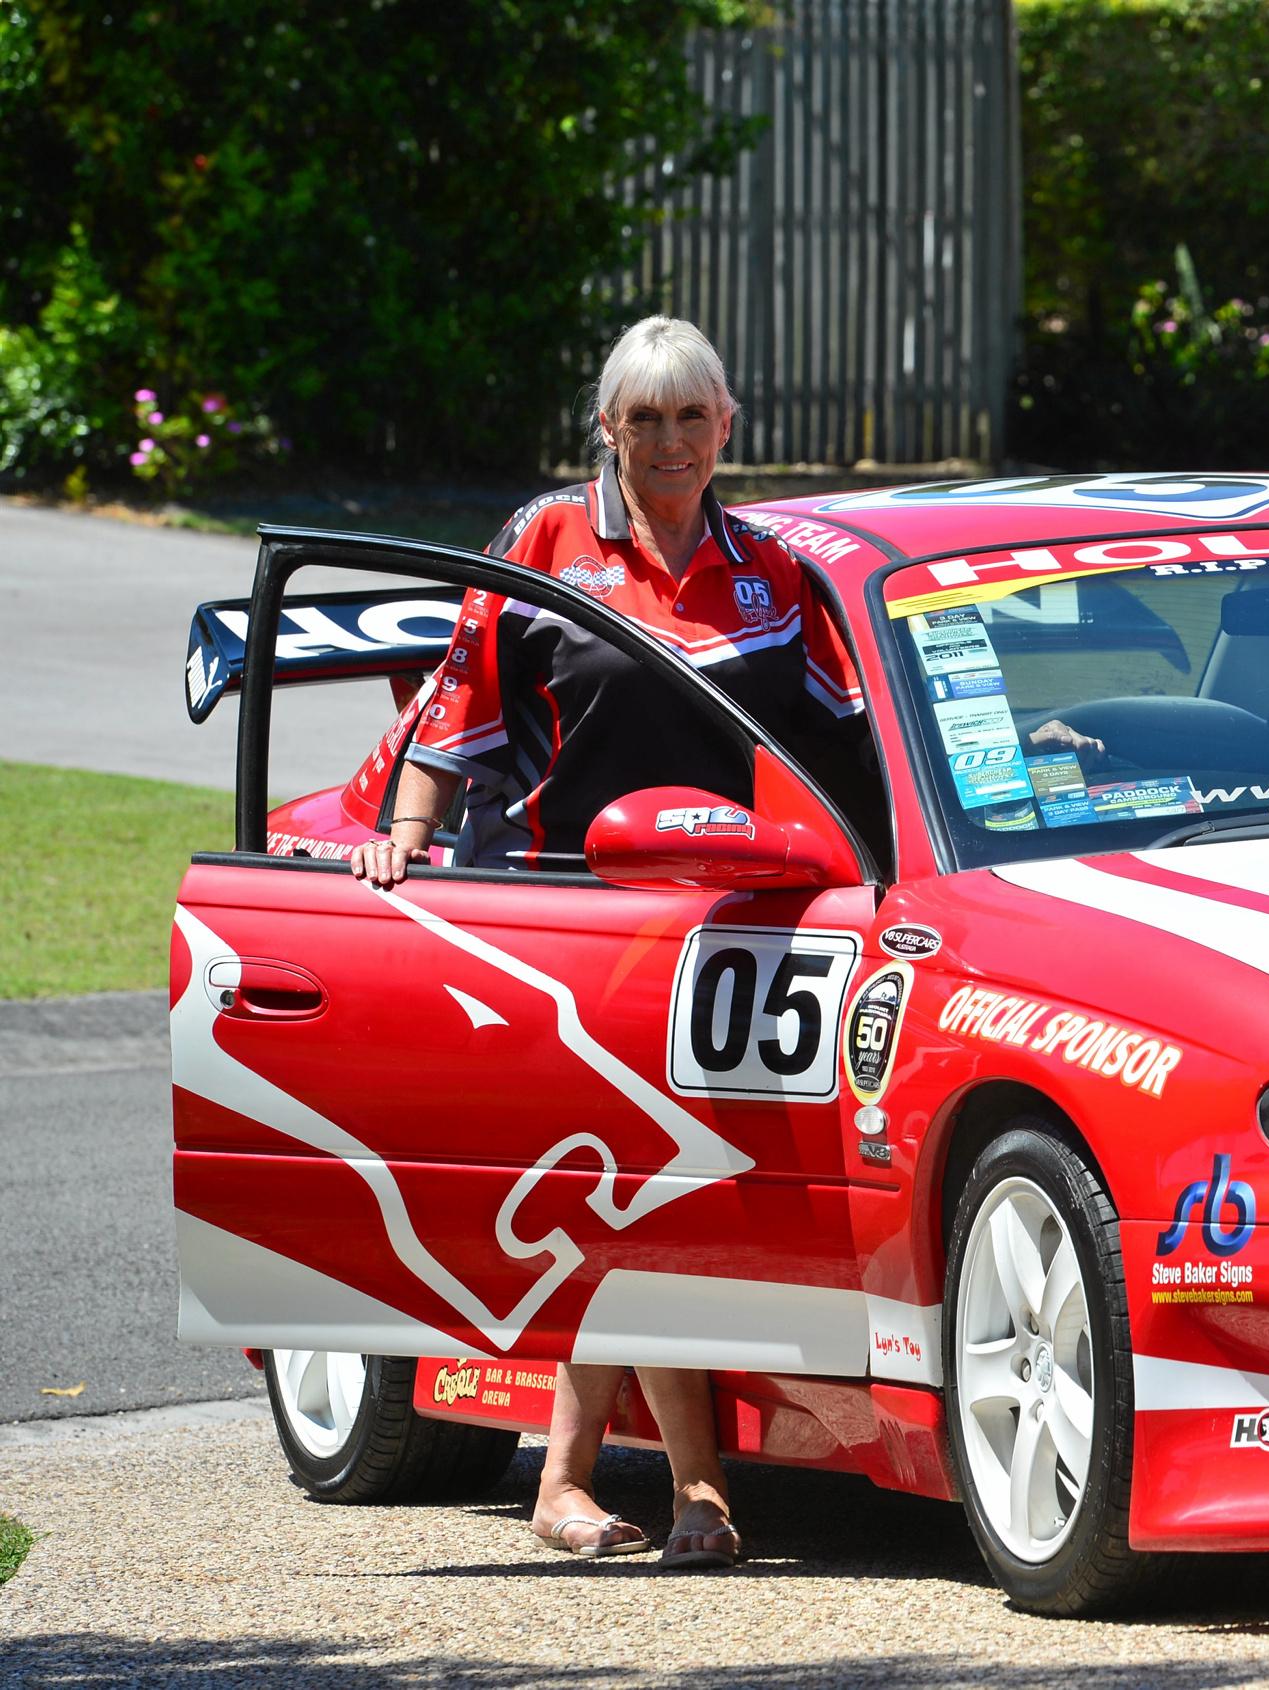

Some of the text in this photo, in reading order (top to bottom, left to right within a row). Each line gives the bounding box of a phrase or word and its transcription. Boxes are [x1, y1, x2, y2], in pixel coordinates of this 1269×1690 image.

[513, 494, 586, 535] BROCK
[783, 521, 860, 564] TEAM
[1150, 557, 1267, 576] R.I.P
[735, 581, 770, 607] 05
[926, 651, 964, 661] 2011
[954, 747, 1017, 771] 09
[1102, 785, 1181, 800] PADDOCK
[1110, 792, 1177, 804] CAMPGROUND
[893, 931, 940, 949] SUPERCARS
[690, 947, 835, 1076] 05
[856, 1016, 888, 1051] 50
[939, 985, 1049, 1045] OFFICIAL
[1031, 1011, 1181, 1096] SPONSOR
[855, 1051, 881, 1070] years
[1152, 1261, 1253, 1287] Steve Baker Signs
[1152, 1288, 1254, 1305] www.stevebakersigns.com
[875, 1332, 922, 1361] Lyn's Toy
[485, 1368, 502, 1383] BAR
[505, 1370, 512, 1385] &
[482, 1390, 511, 1407] OREWA
